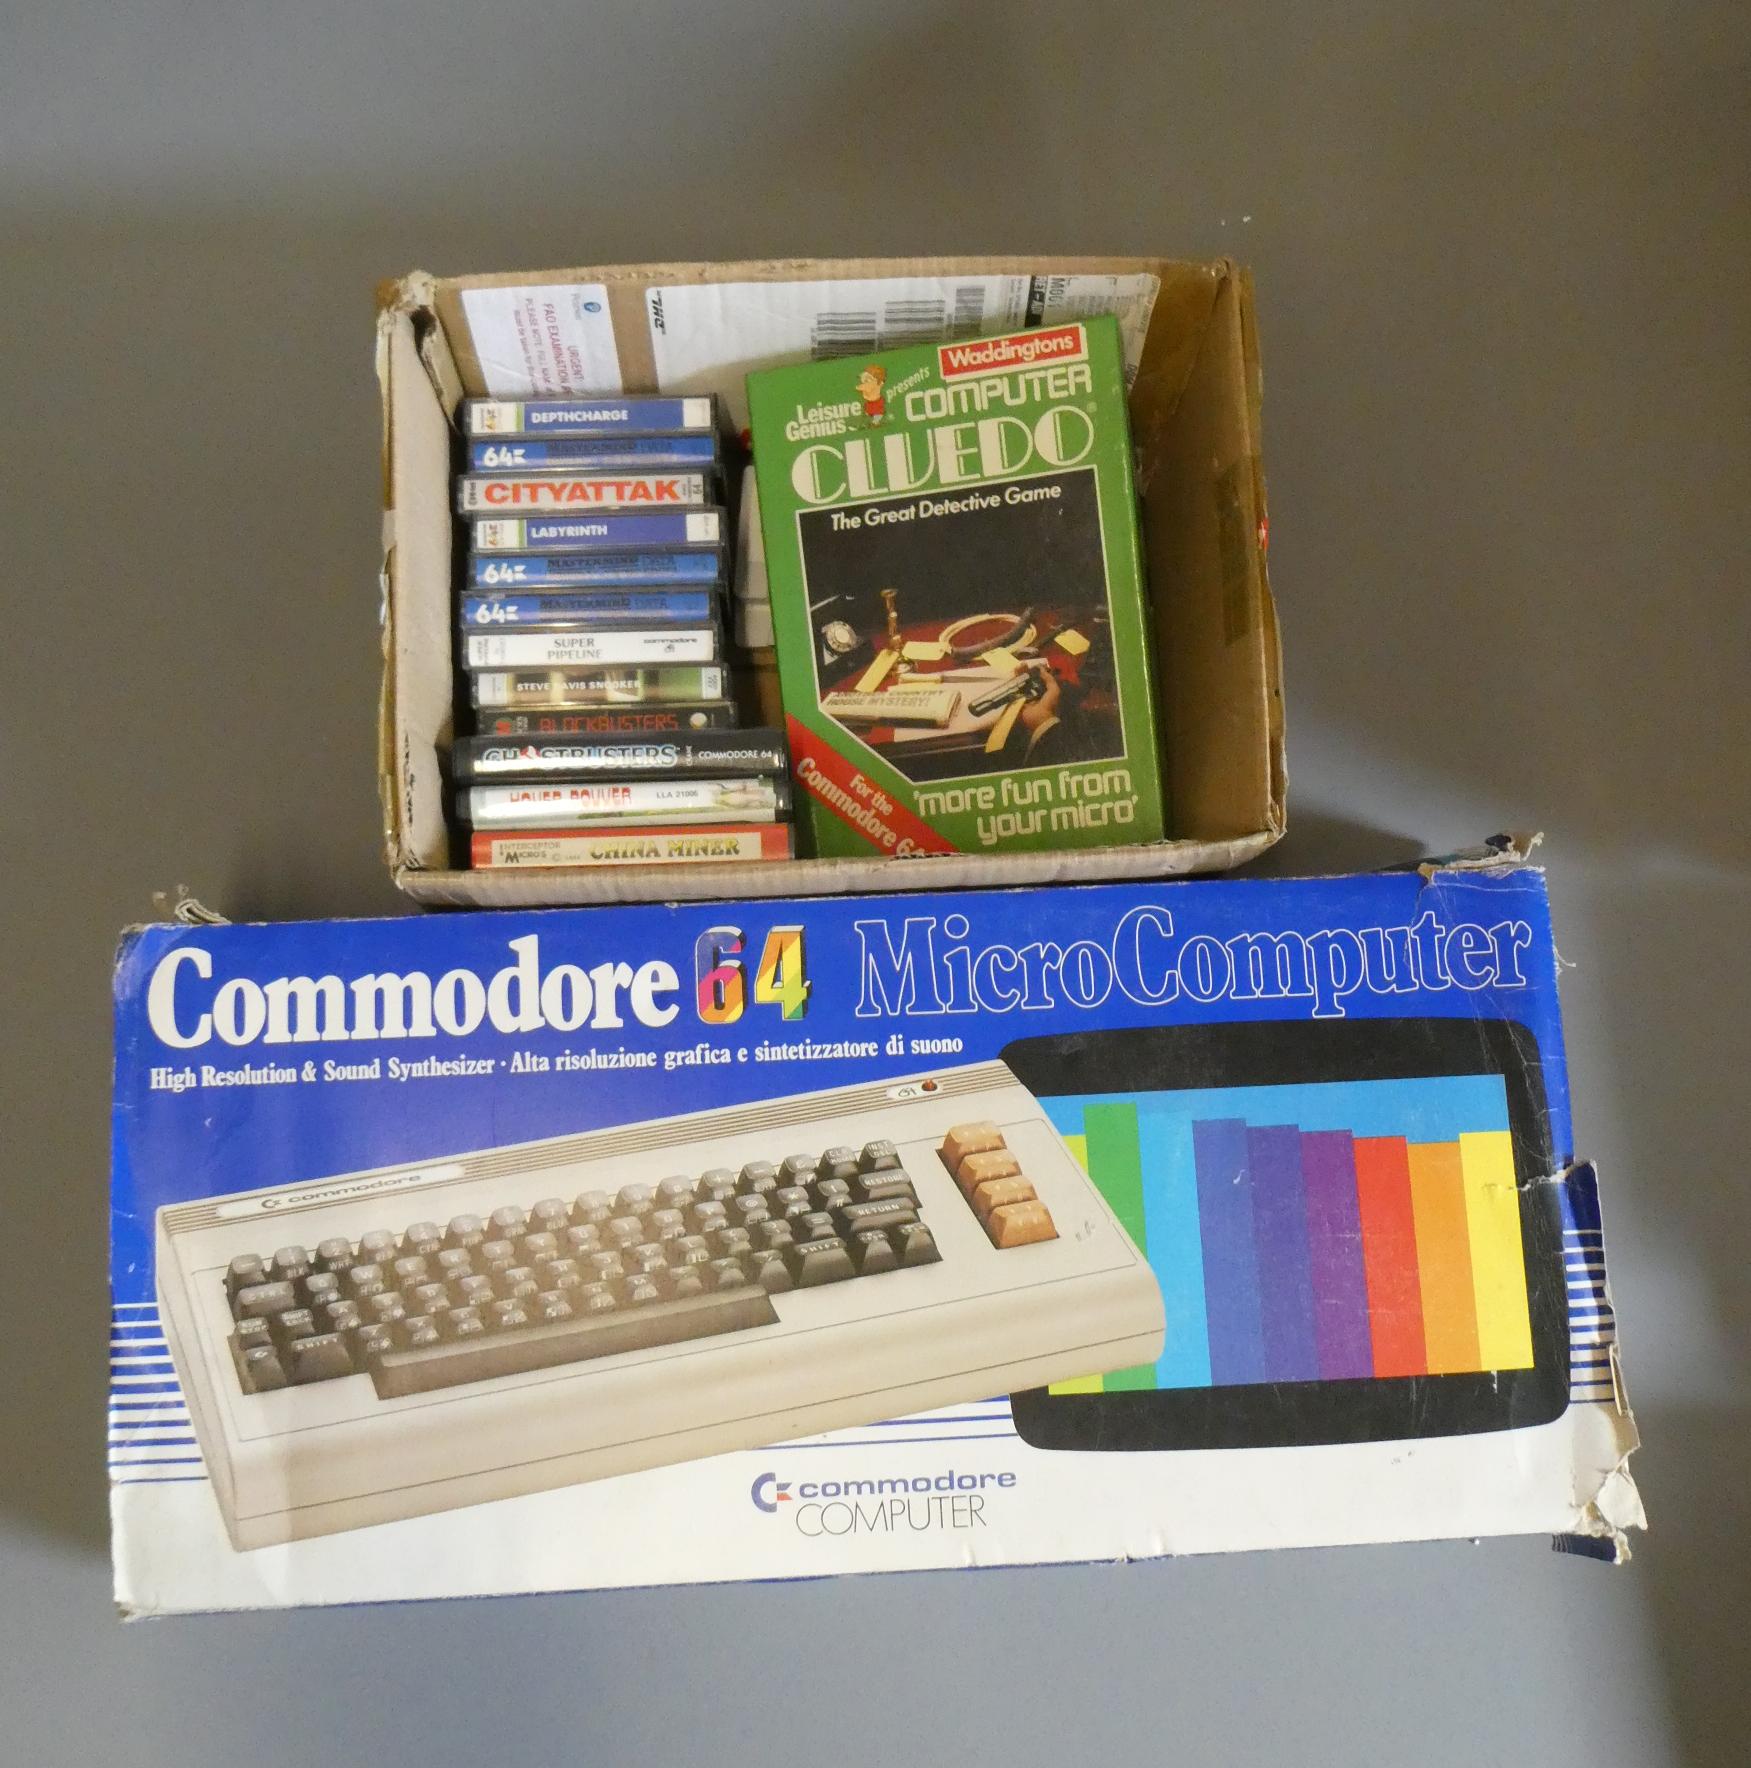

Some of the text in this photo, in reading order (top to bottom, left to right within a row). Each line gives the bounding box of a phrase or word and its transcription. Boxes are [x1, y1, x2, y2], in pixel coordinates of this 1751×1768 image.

[546, 325, 570, 384] EXAMINATION
[567, 345, 585, 381] URGENT
[948, 334, 1074, 368] Waddingtons
[886, 366, 930, 402] presents
[905, 364, 1092, 421] COMPUTER
[531, 410, 629, 424] DEPTHCHARGE
[797, 401, 862, 425] Leisure
[786, 419, 847, 442] Genius
[792, 405, 1095, 504] CLUEDO
[484, 479, 681, 505] CITYATTAK
[832, 483, 1062, 531] The Great Detective Game
[531, 525, 608, 538] LABYRINTH
[547, 649, 603, 660] PIPELINE
[554, 638, 595, 649] SUPER
[516, 682, 549, 692] STEVE
[540, 713, 679, 735] BLOCKBUSTERS
[698, 750, 760, 760] COMMODORE
[761, 749, 773, 759] 64
[656, 791, 673, 800] LLA
[796, 757, 897, 848] Commodore
[849, 774, 894, 817] For the
[1001, 777, 1053, 807] fun
[1059, 768, 1131, 799] from
[977, 808, 1049, 846] your
[590, 838, 741, 860] CHINA MINER
[147, 905, 1532, 1049] Commodore 64 MicroComputer
[151, 1035, 963, 1093] High Resolution & Sound Synthesizer Alta risoluzione grafica e sintetizzatore di suono
[288, 1174, 422, 1204] commodore
[799, 1470, 1017, 1498] commodore
[795, 1495, 987, 1537] COMPUTER
